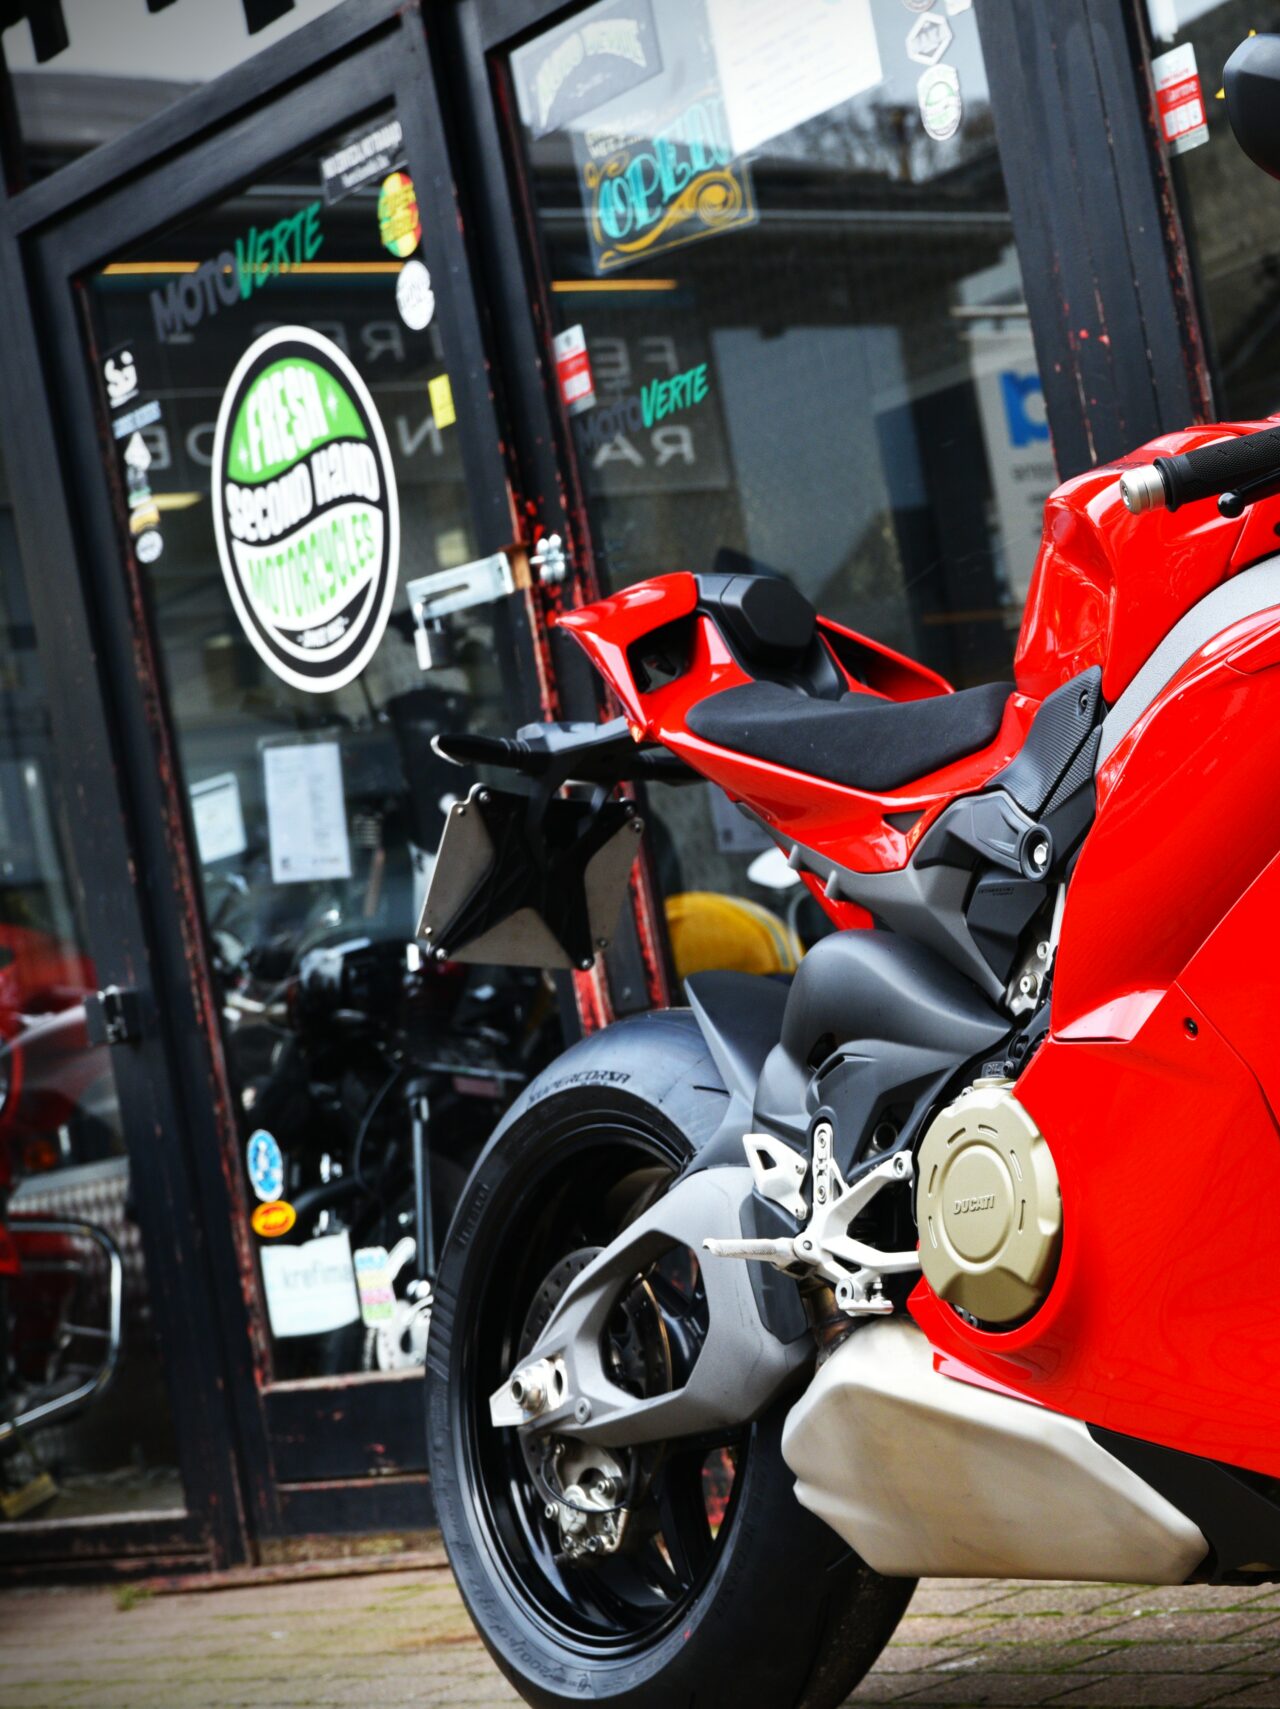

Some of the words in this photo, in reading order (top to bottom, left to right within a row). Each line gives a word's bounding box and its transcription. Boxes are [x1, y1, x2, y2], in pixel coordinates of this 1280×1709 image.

[246, 366, 330, 475] FRESH
[248, 512, 375, 618] MOTORCYCLES
[953, 1194, 995, 1215] DUCATI
